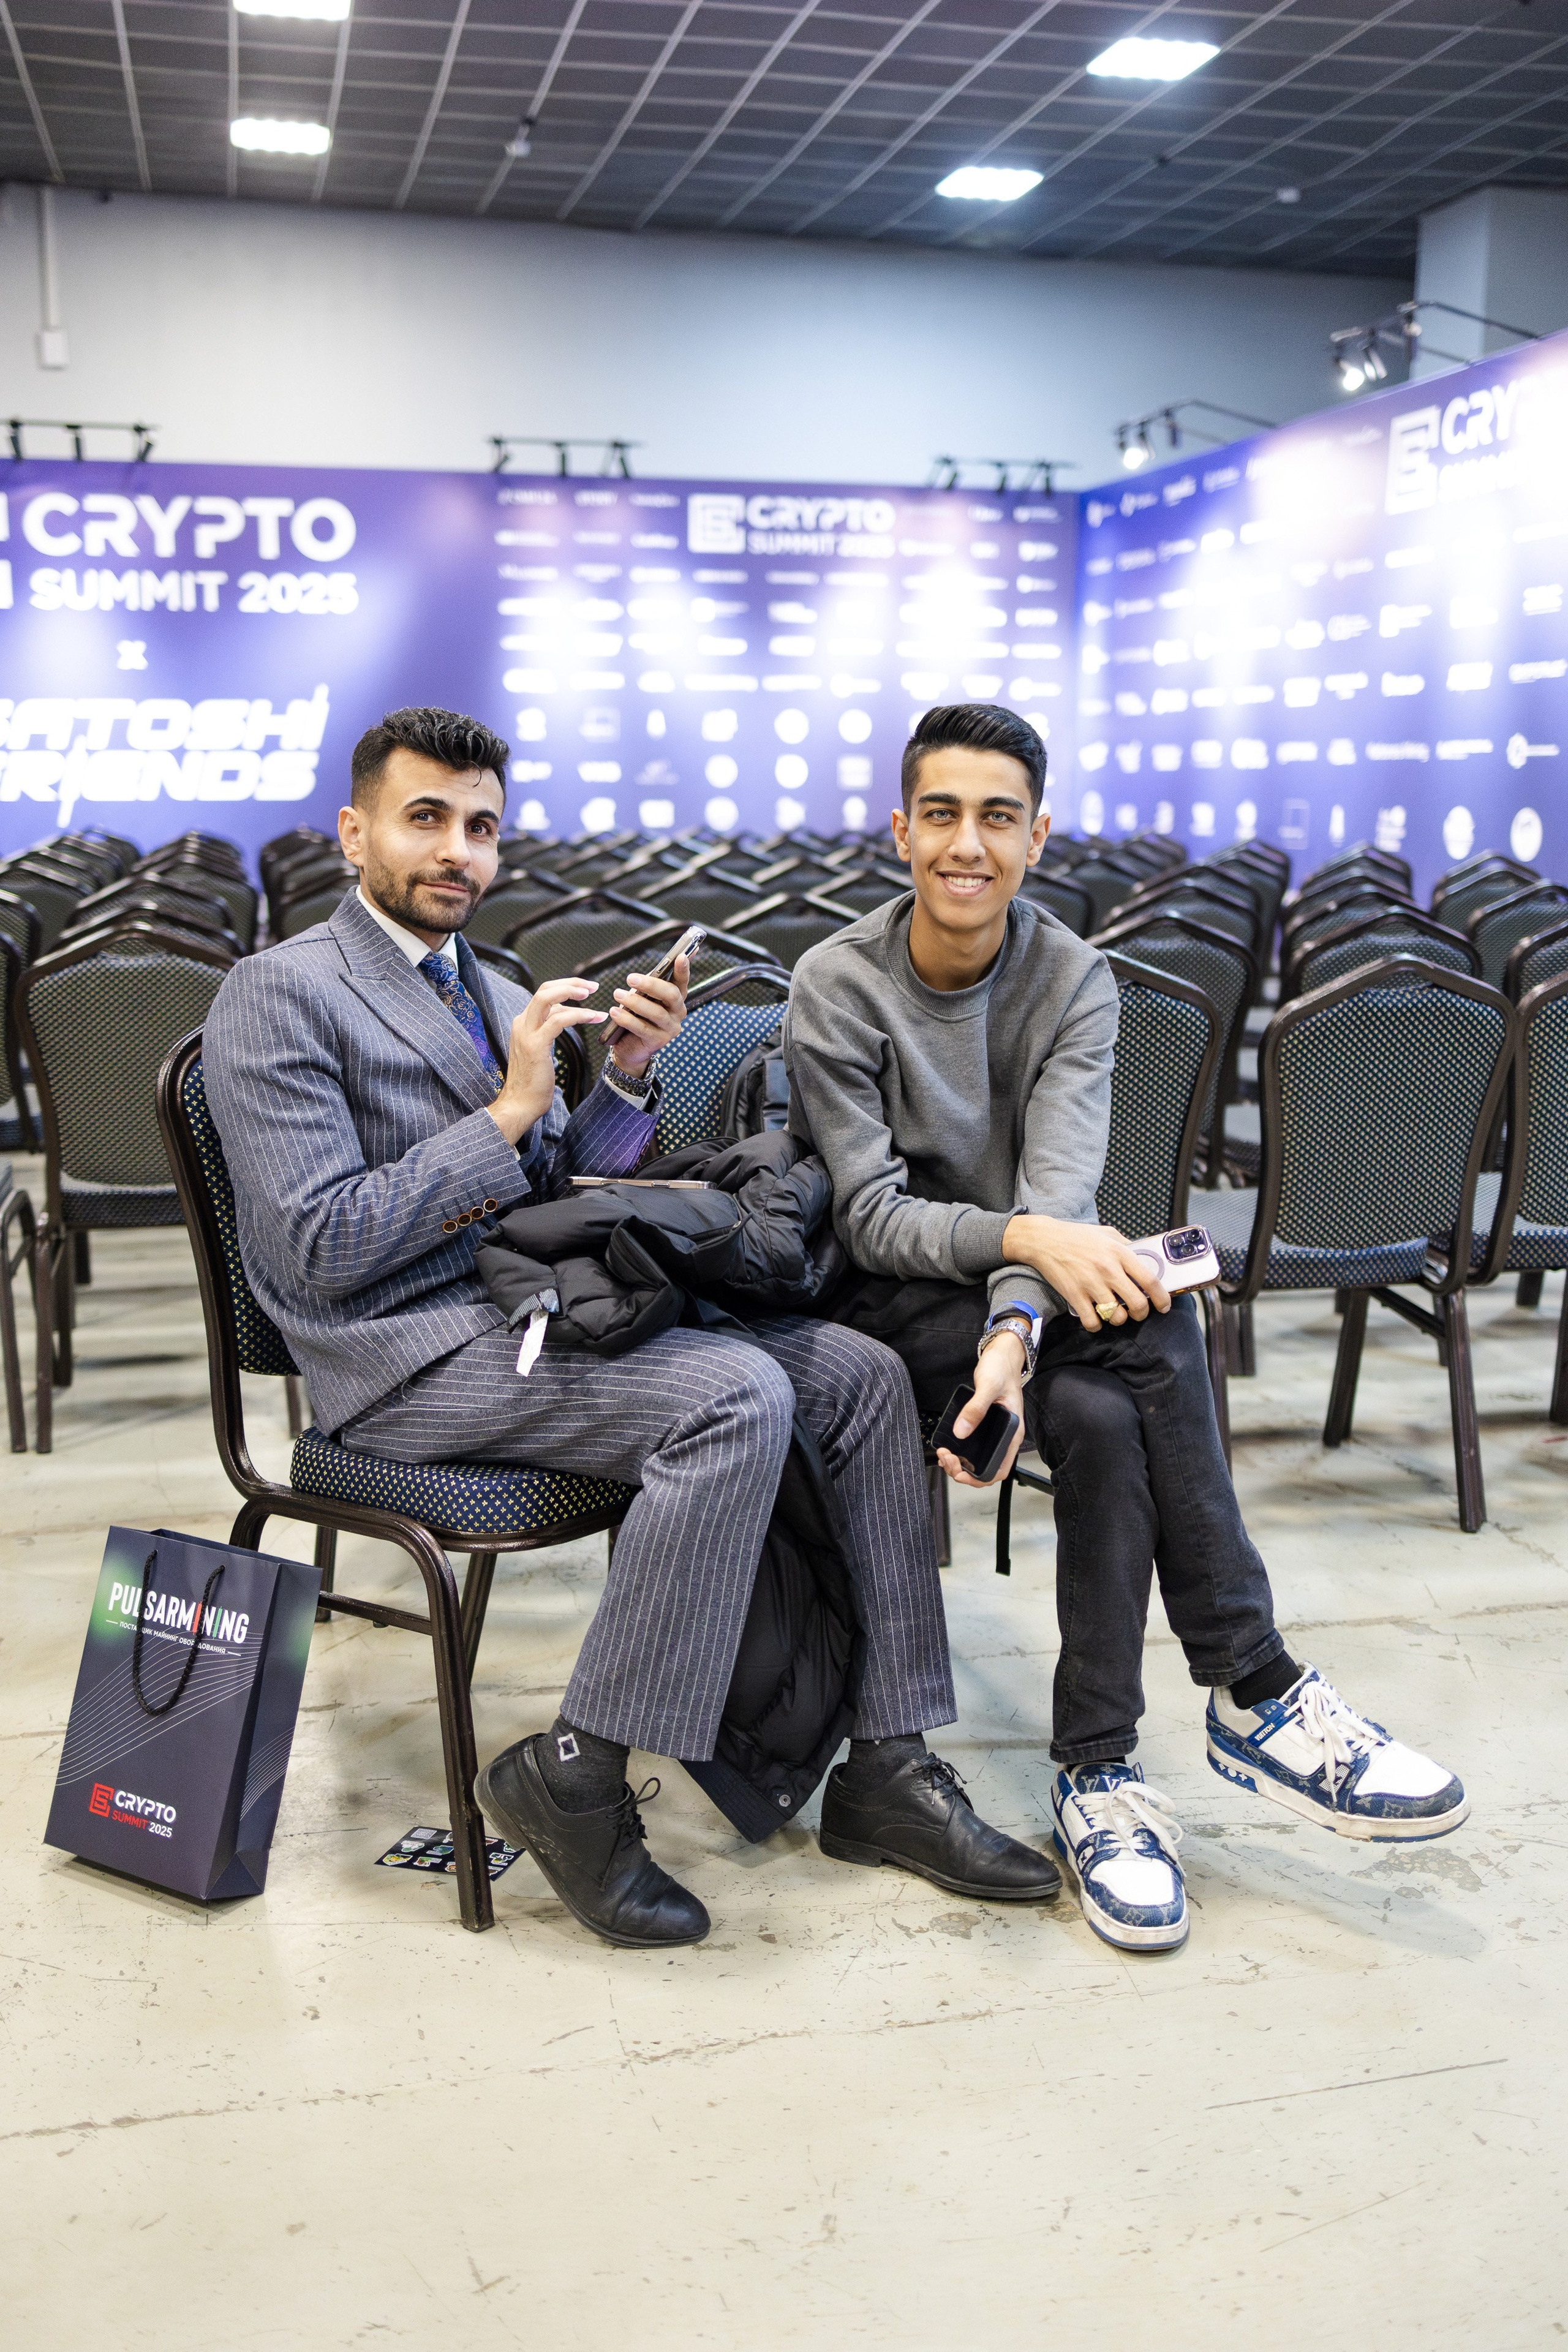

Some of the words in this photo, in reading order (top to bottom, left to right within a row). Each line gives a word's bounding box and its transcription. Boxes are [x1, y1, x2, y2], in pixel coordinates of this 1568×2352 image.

[22, 492, 357, 562] CRYPTO
[747, 495, 895, 534] CRYPTO
[29, 568, 228, 612] SUMMIT
[238, 572, 359, 614] 2025
[0, 683, 330, 751] ATOSHI
[0, 735, 320, 828] RIENDS
[108, 1582, 249, 1644] PULSARMINING
[119, 1621, 153, 1635] ПОСТАЩИК
[153, 1630, 178, 1643] МАЙНИНГ
[179, 1637, 226, 1654] ОБОРДОВАНИЯ
[1254, 1722, 1275, 1741] VUITTON
[112, 1810, 148, 1830] SUMMIT
[149, 1822, 173, 1838] 2025
[115, 1790, 176, 1823] CRYPTO
